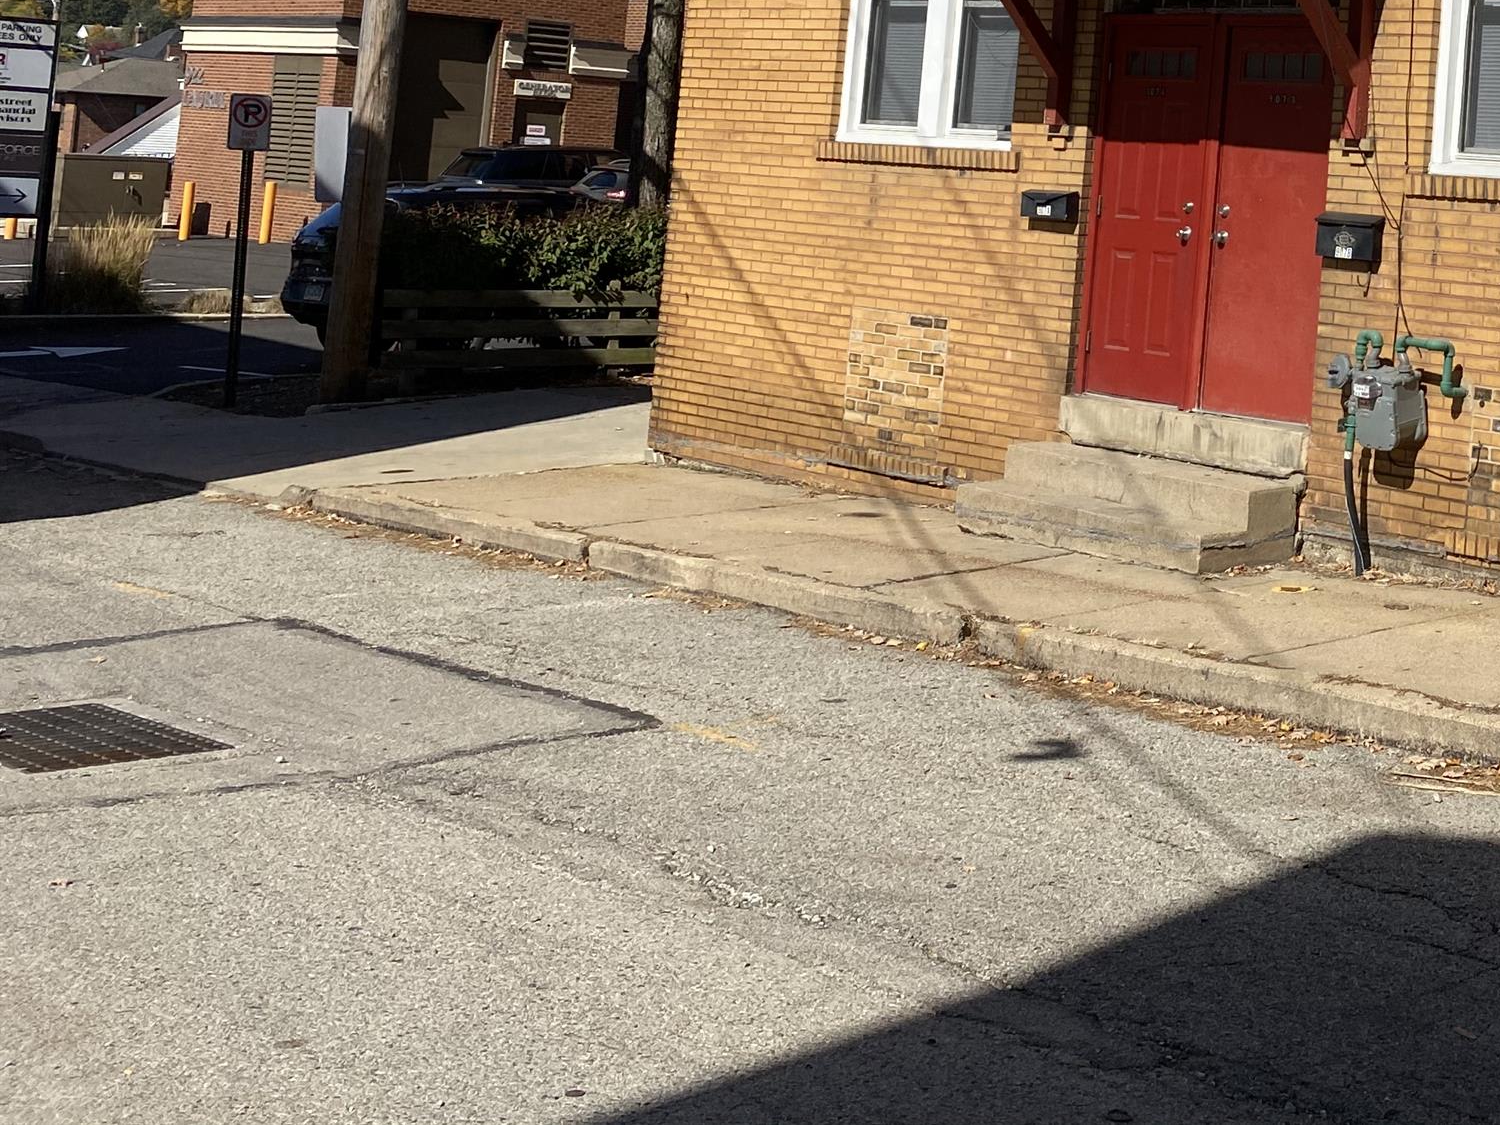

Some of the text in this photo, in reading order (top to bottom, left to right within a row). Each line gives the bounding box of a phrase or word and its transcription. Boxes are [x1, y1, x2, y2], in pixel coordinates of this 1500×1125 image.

[2, 23, 42, 33] PARKING
[19, 34, 42, 43] ONLY
[0, 106, 36, 115] ancial
